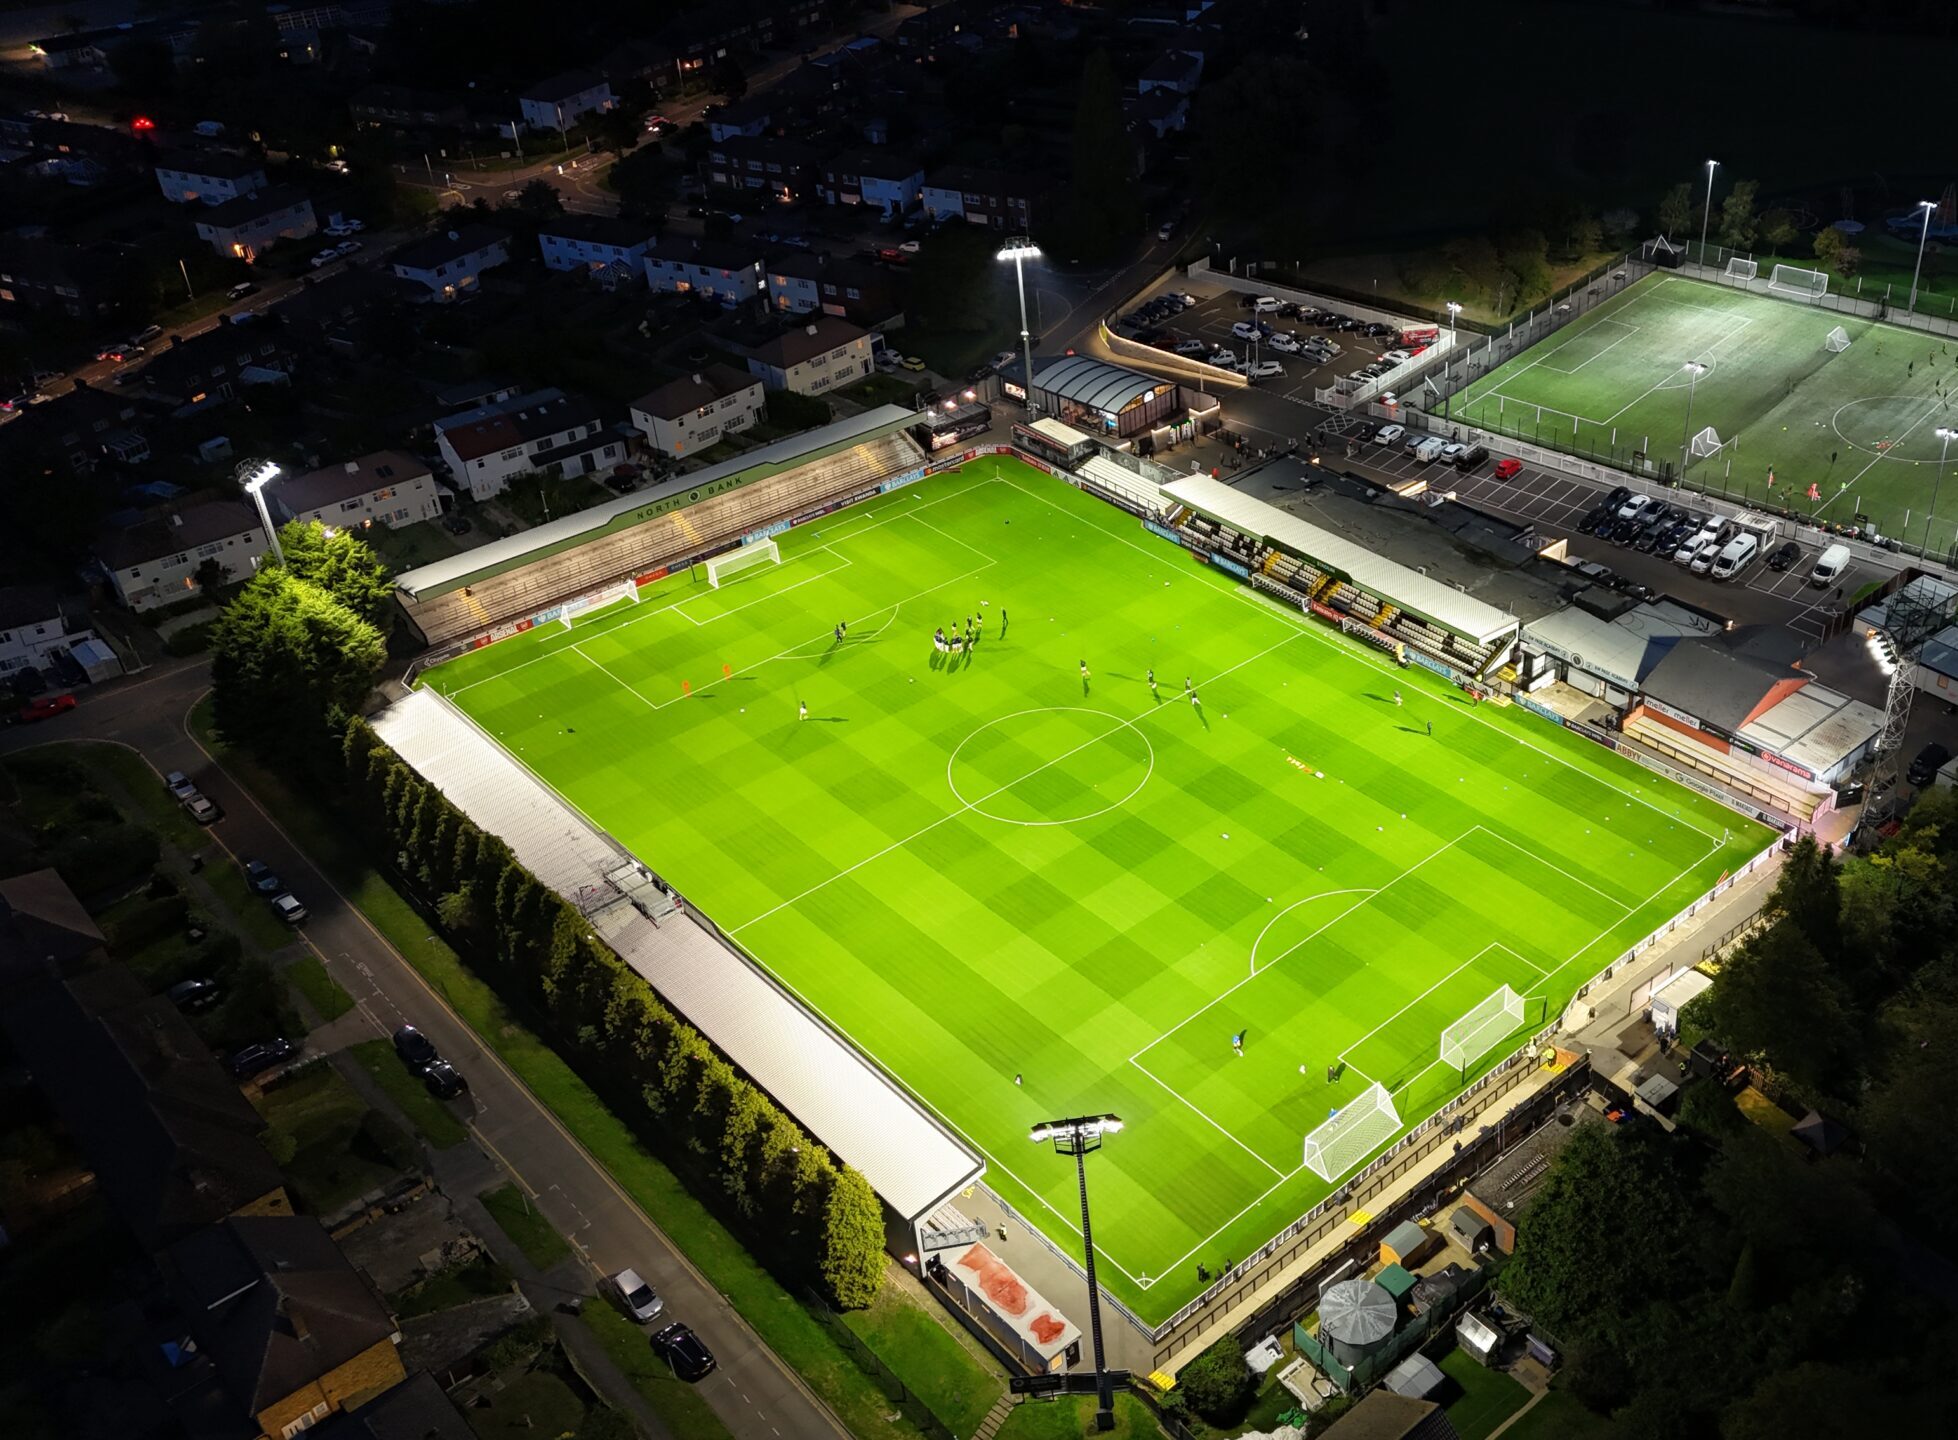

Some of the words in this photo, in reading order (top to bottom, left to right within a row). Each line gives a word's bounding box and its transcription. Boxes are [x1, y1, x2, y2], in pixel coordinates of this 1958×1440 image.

[892, 472, 920, 488] BARCLAYS
[637, 499, 680, 519] NORTH
[708, 477, 742, 495] BANK
[1415, 653, 1447, 678] BARCLAYS
[1526, 701, 1559, 723] BARCLAYS
[1646, 700, 1669, 713] meller
[1674, 712, 1697, 726] meller
[1616, 745, 1641, 761] ABBYY
[1771, 756, 1811, 779] vanarama
